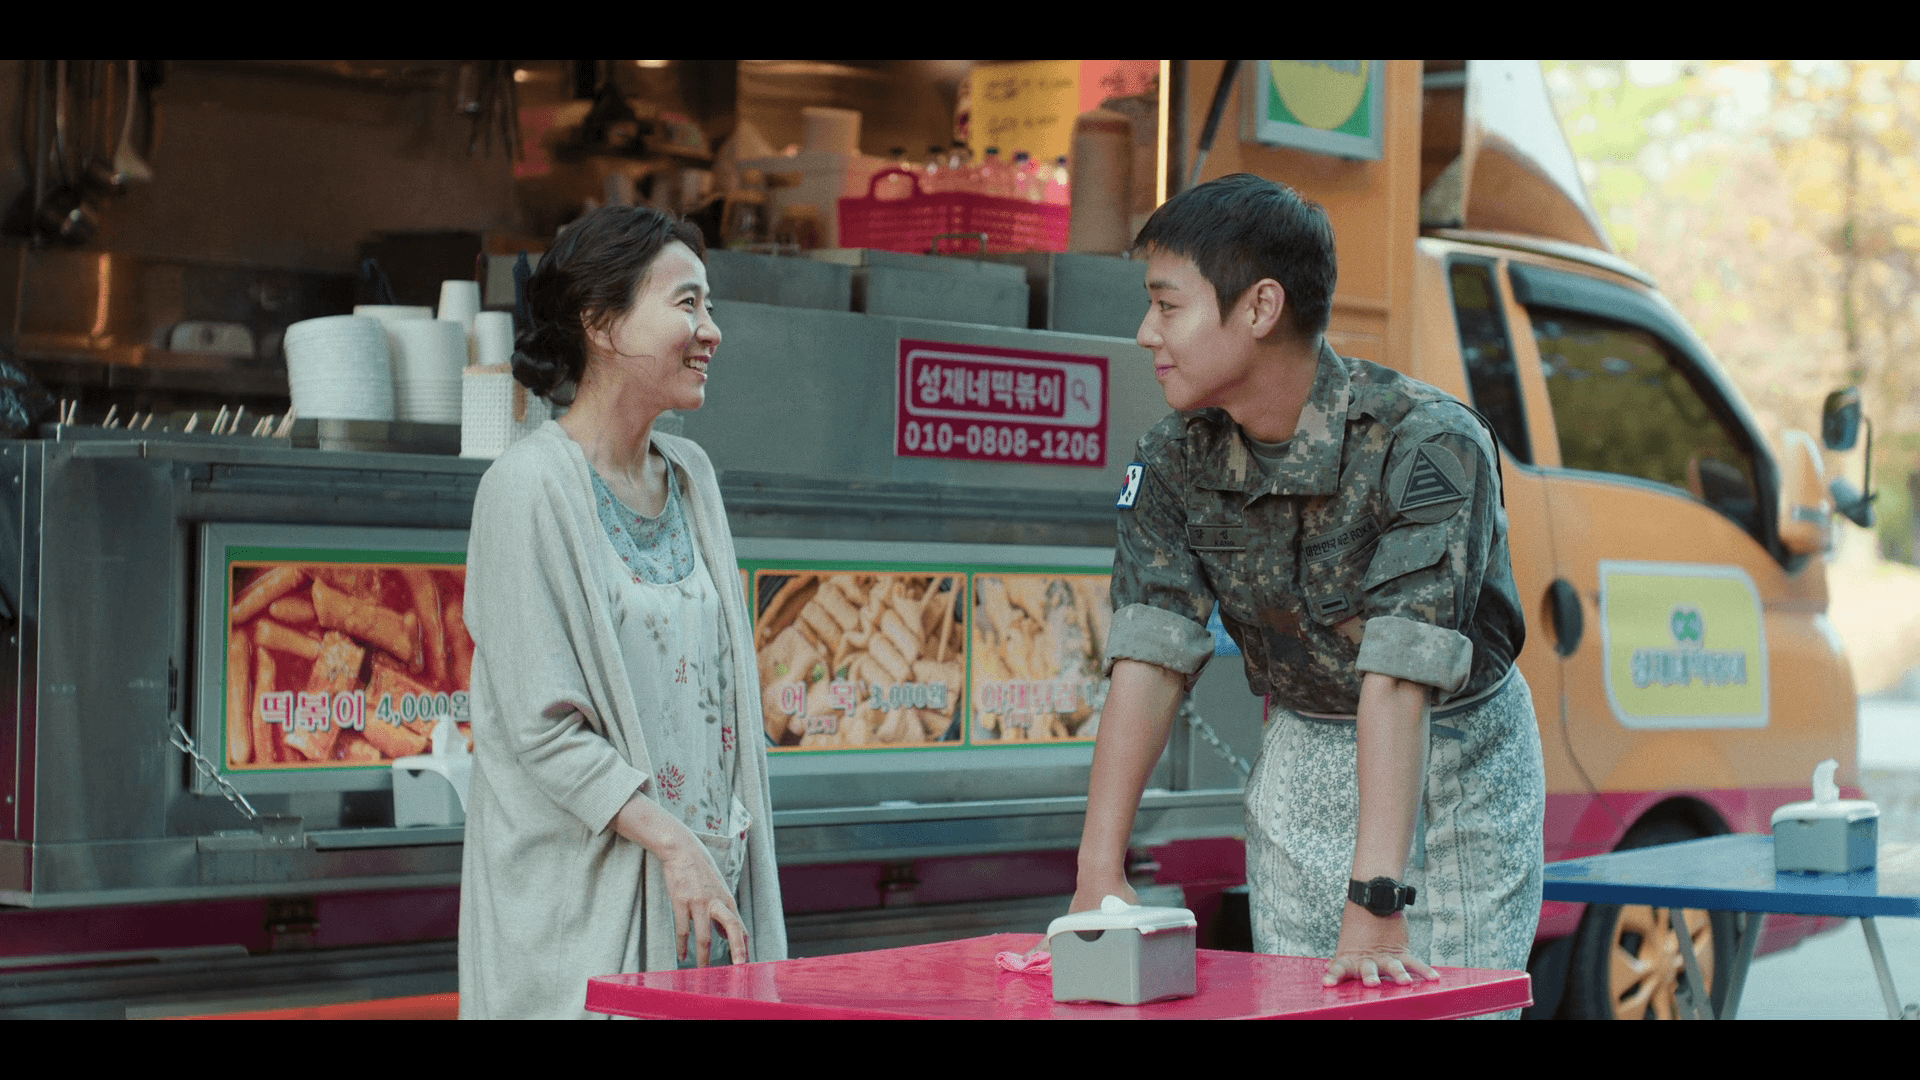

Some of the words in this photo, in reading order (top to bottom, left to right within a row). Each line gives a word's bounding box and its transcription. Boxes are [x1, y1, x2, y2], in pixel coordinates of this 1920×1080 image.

[916, 364, 1061, 412] 성재네떡볶이
[904, 420, 1100, 461] 010-0808-1206
[260, 690, 367, 732] 떡볶이
